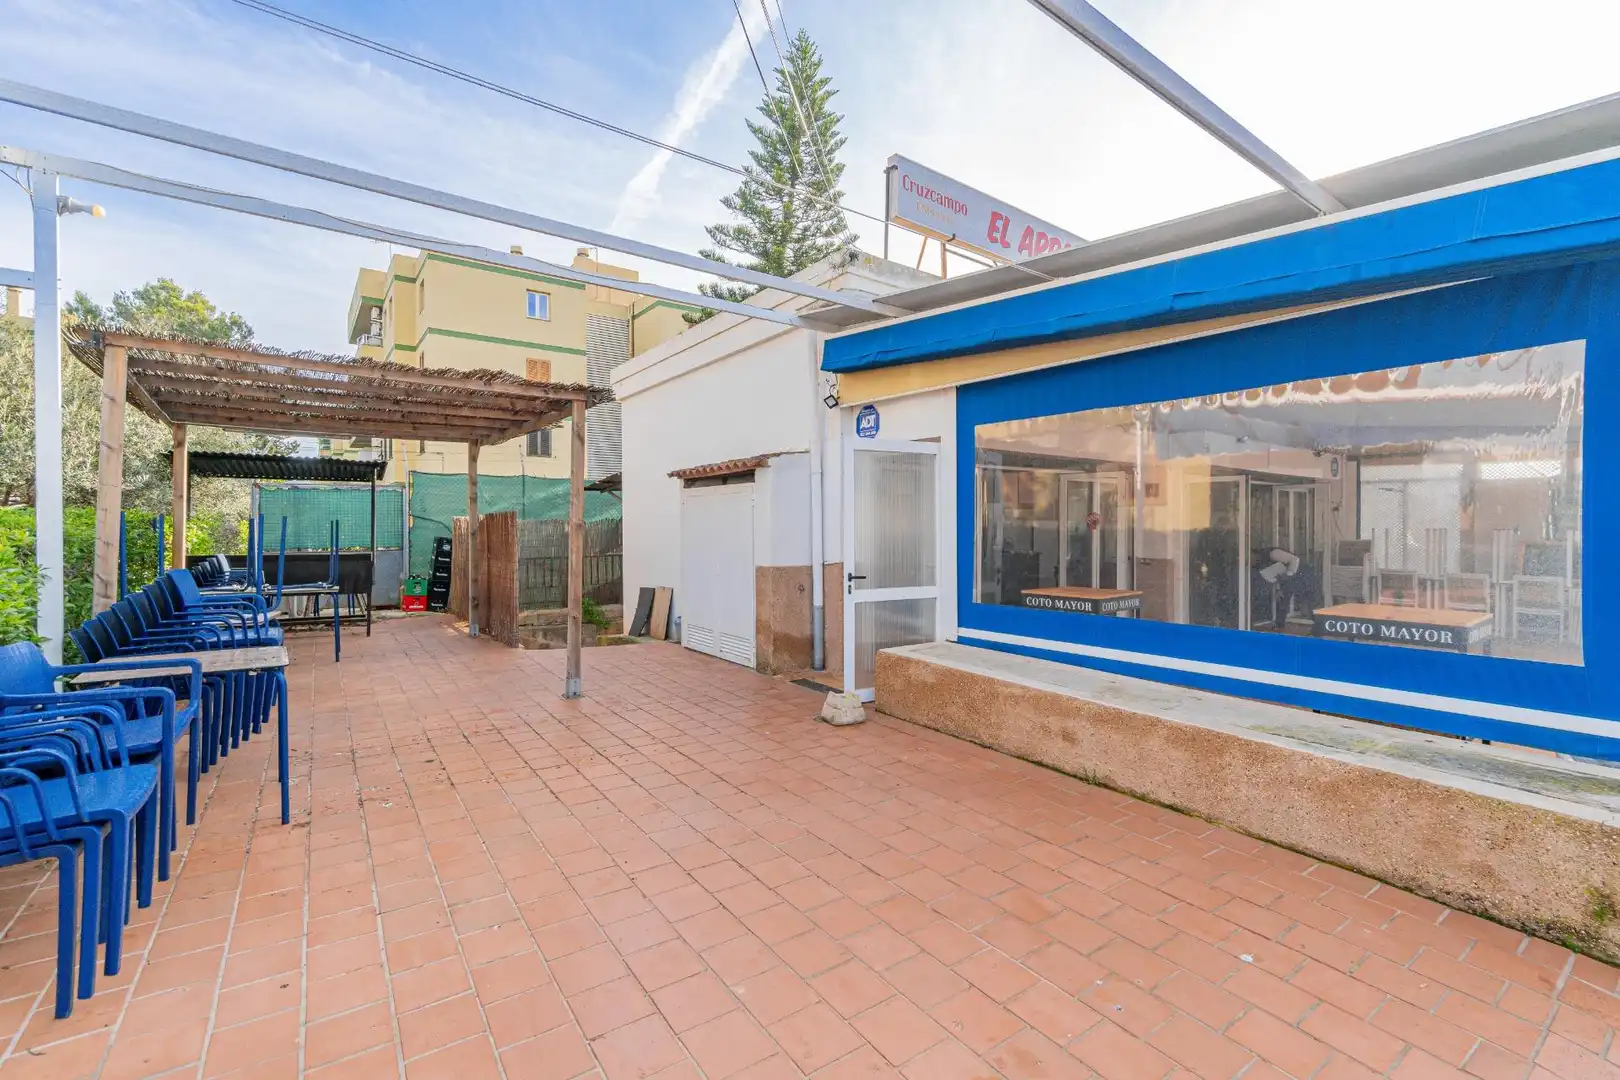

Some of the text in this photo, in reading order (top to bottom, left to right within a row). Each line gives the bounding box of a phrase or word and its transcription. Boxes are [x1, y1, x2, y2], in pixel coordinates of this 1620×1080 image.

[902, 174, 968, 217] Cruzcampo
[986, 210, 1011, 249] EL
[861, 415, 875, 428] ADT
[1026, 596, 1092, 612] COTO MAYOR
[1101, 598, 1141, 612] COTO MAYOR
[1324, 619, 1374, 636] COTO
[1380, 624, 1453, 644] MAYOR
